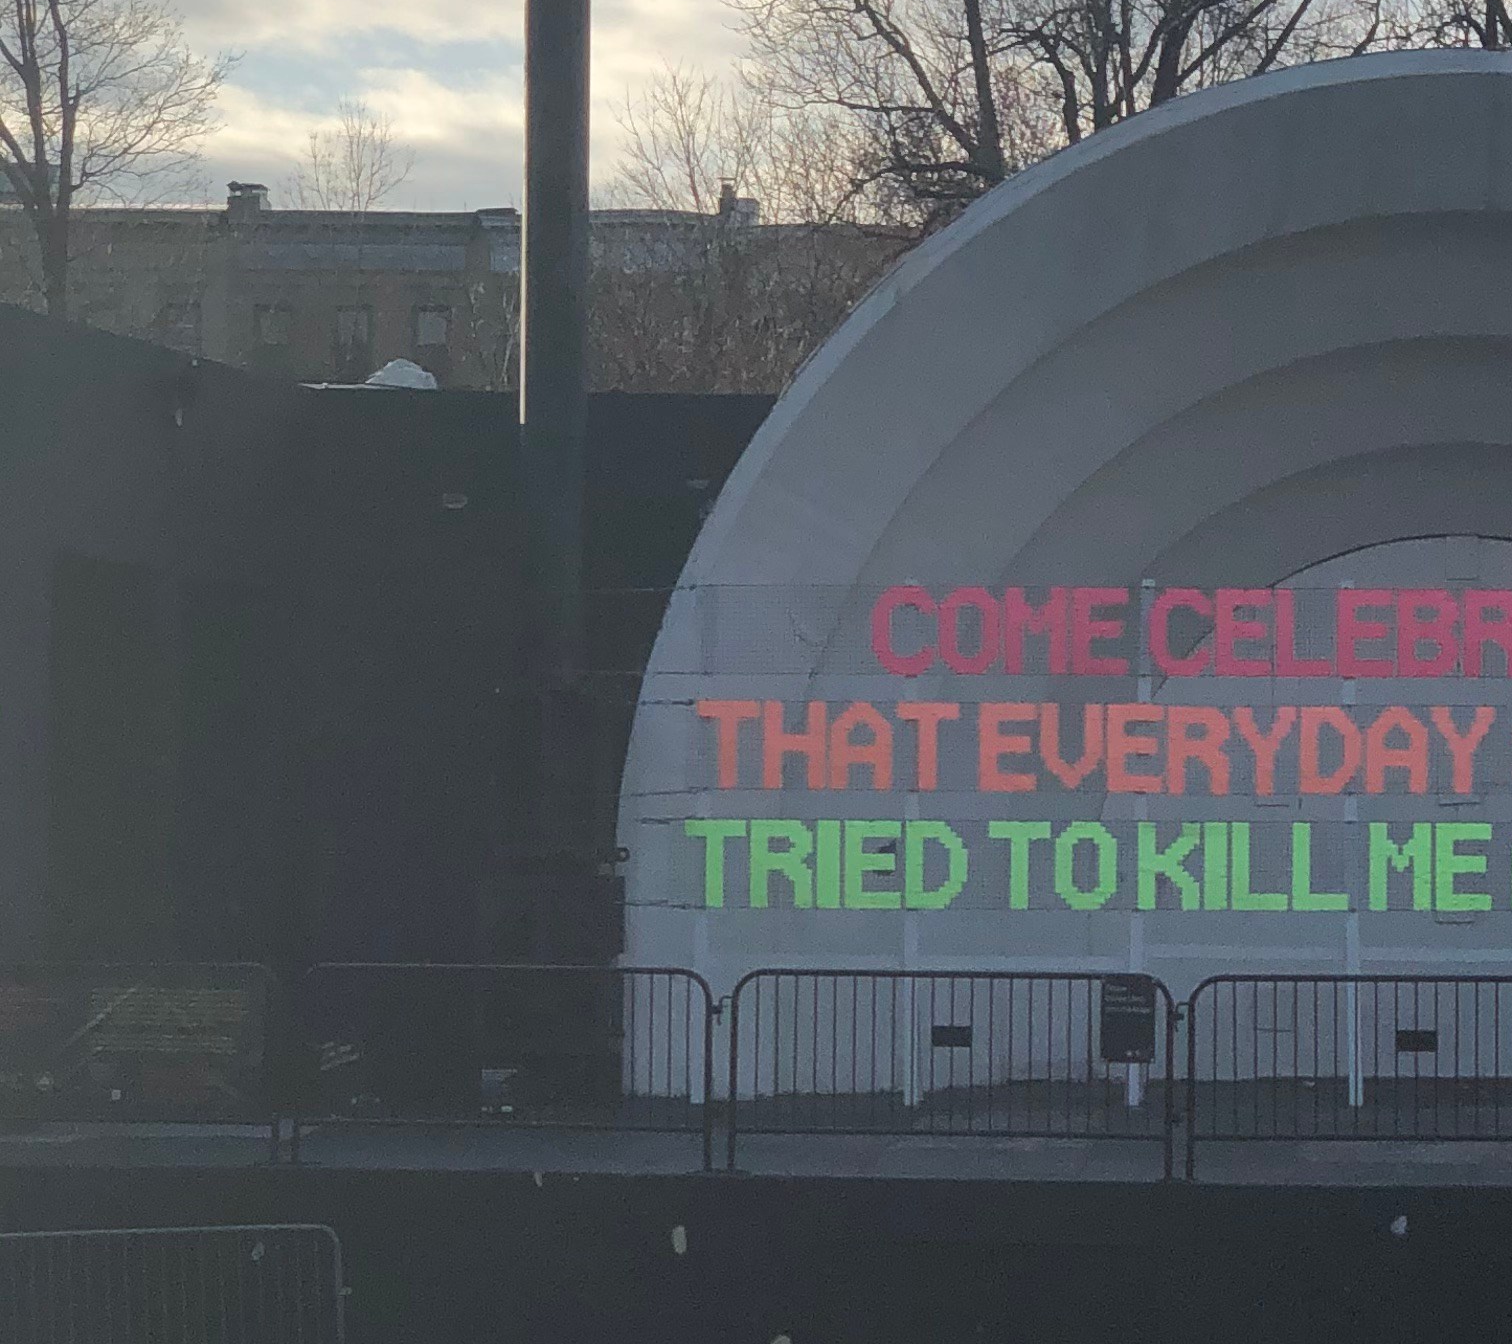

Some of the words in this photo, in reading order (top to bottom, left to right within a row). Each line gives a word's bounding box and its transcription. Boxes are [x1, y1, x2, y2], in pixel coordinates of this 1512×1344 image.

[871, 585, 1129, 677] COME
[696, 699, 960, 790] THAT
[978, 701, 1495, 796] EVERYDAY
[684, 819, 968, 910] TRIED
[988, 820, 1118, 911] TO
[1136, 821, 1349, 912] KILL
[1368, 821, 1494, 912] ME
